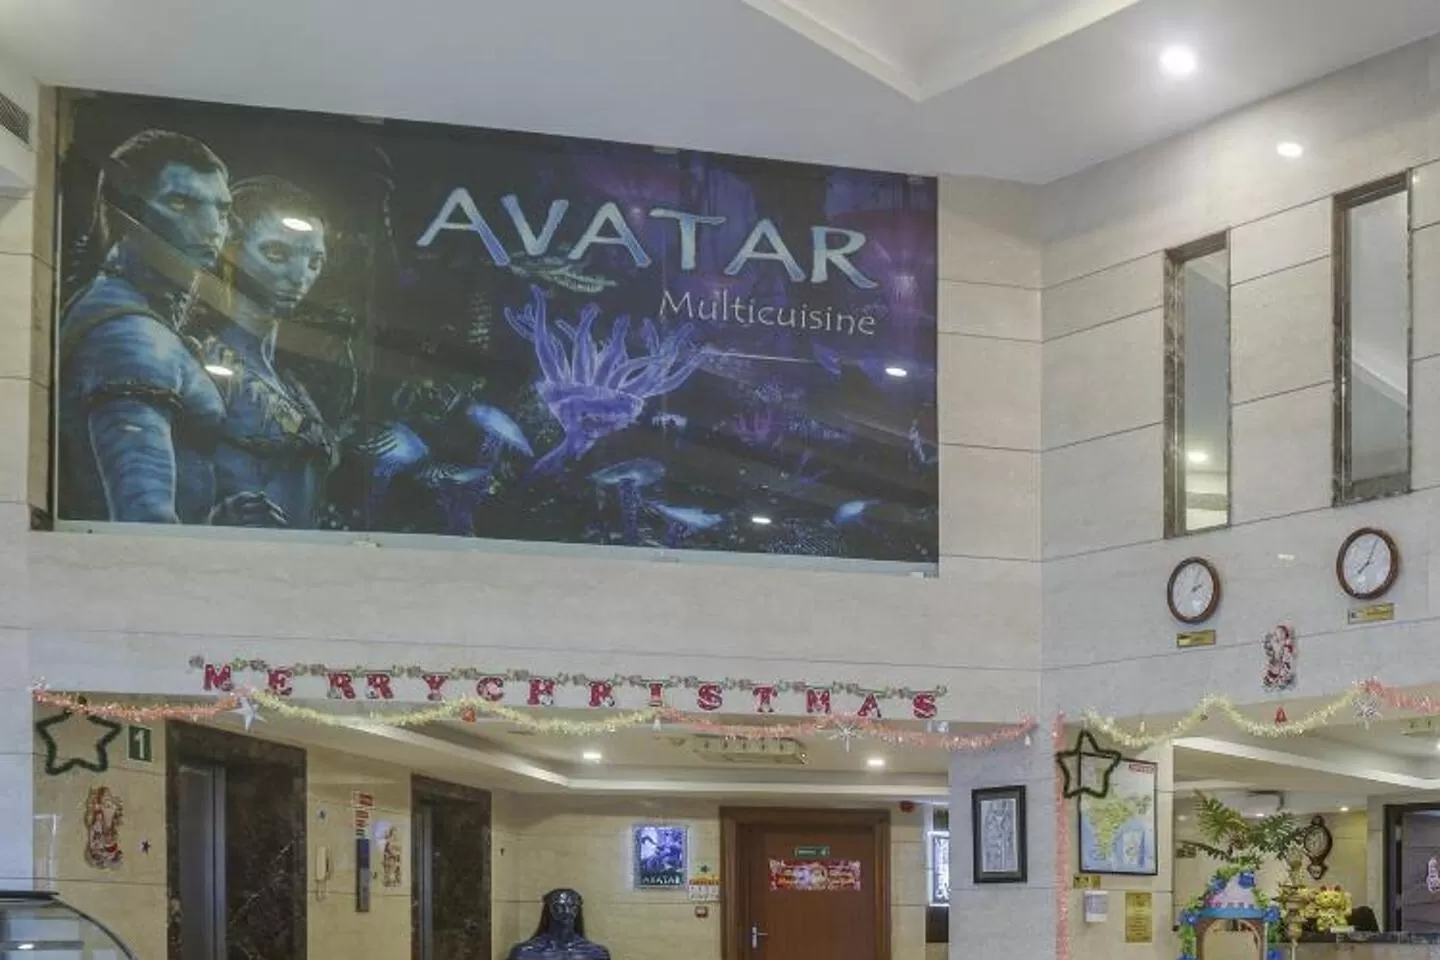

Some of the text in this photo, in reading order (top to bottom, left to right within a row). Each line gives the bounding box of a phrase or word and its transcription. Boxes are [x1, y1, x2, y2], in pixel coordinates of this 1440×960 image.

[416, 187, 878, 289] AVATAR
[659, 289, 877, 335] Multicuisine
[134, 730, 144, 759] 1
